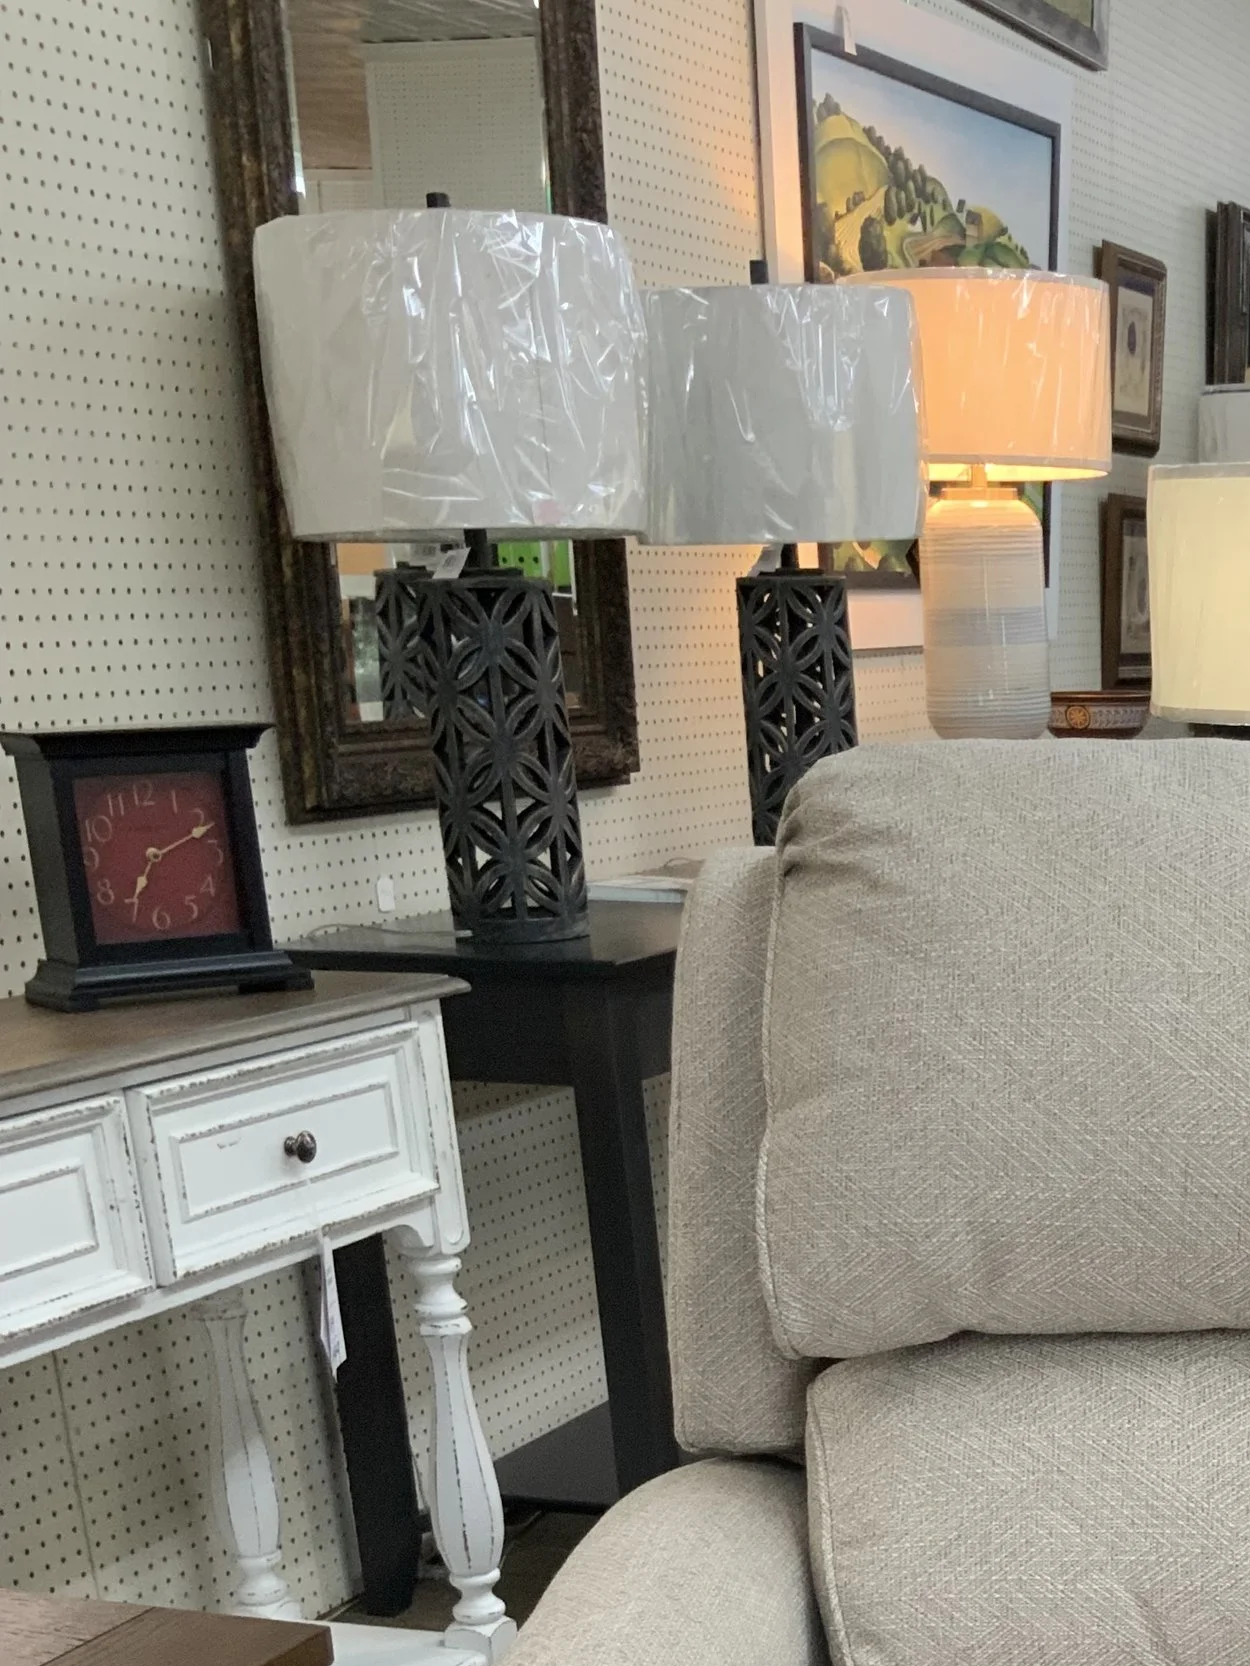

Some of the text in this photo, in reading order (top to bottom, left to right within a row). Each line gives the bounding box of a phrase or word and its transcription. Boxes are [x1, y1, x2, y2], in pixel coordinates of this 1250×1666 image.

[106, 793, 125, 817] 11
[133, 780, 157, 807] 12
[171, 789, 178, 814] 1
[85, 815, 113, 843] 10
[83, 846, 100, 872] 9
[206, 839, 224, 867] 3
[97, 878, 115, 906] 8
[200, 873, 216, 897] 4
[124, 897, 139, 923] 7
[152, 906, 171, 930] 6
[184, 895, 199, 921] 5
